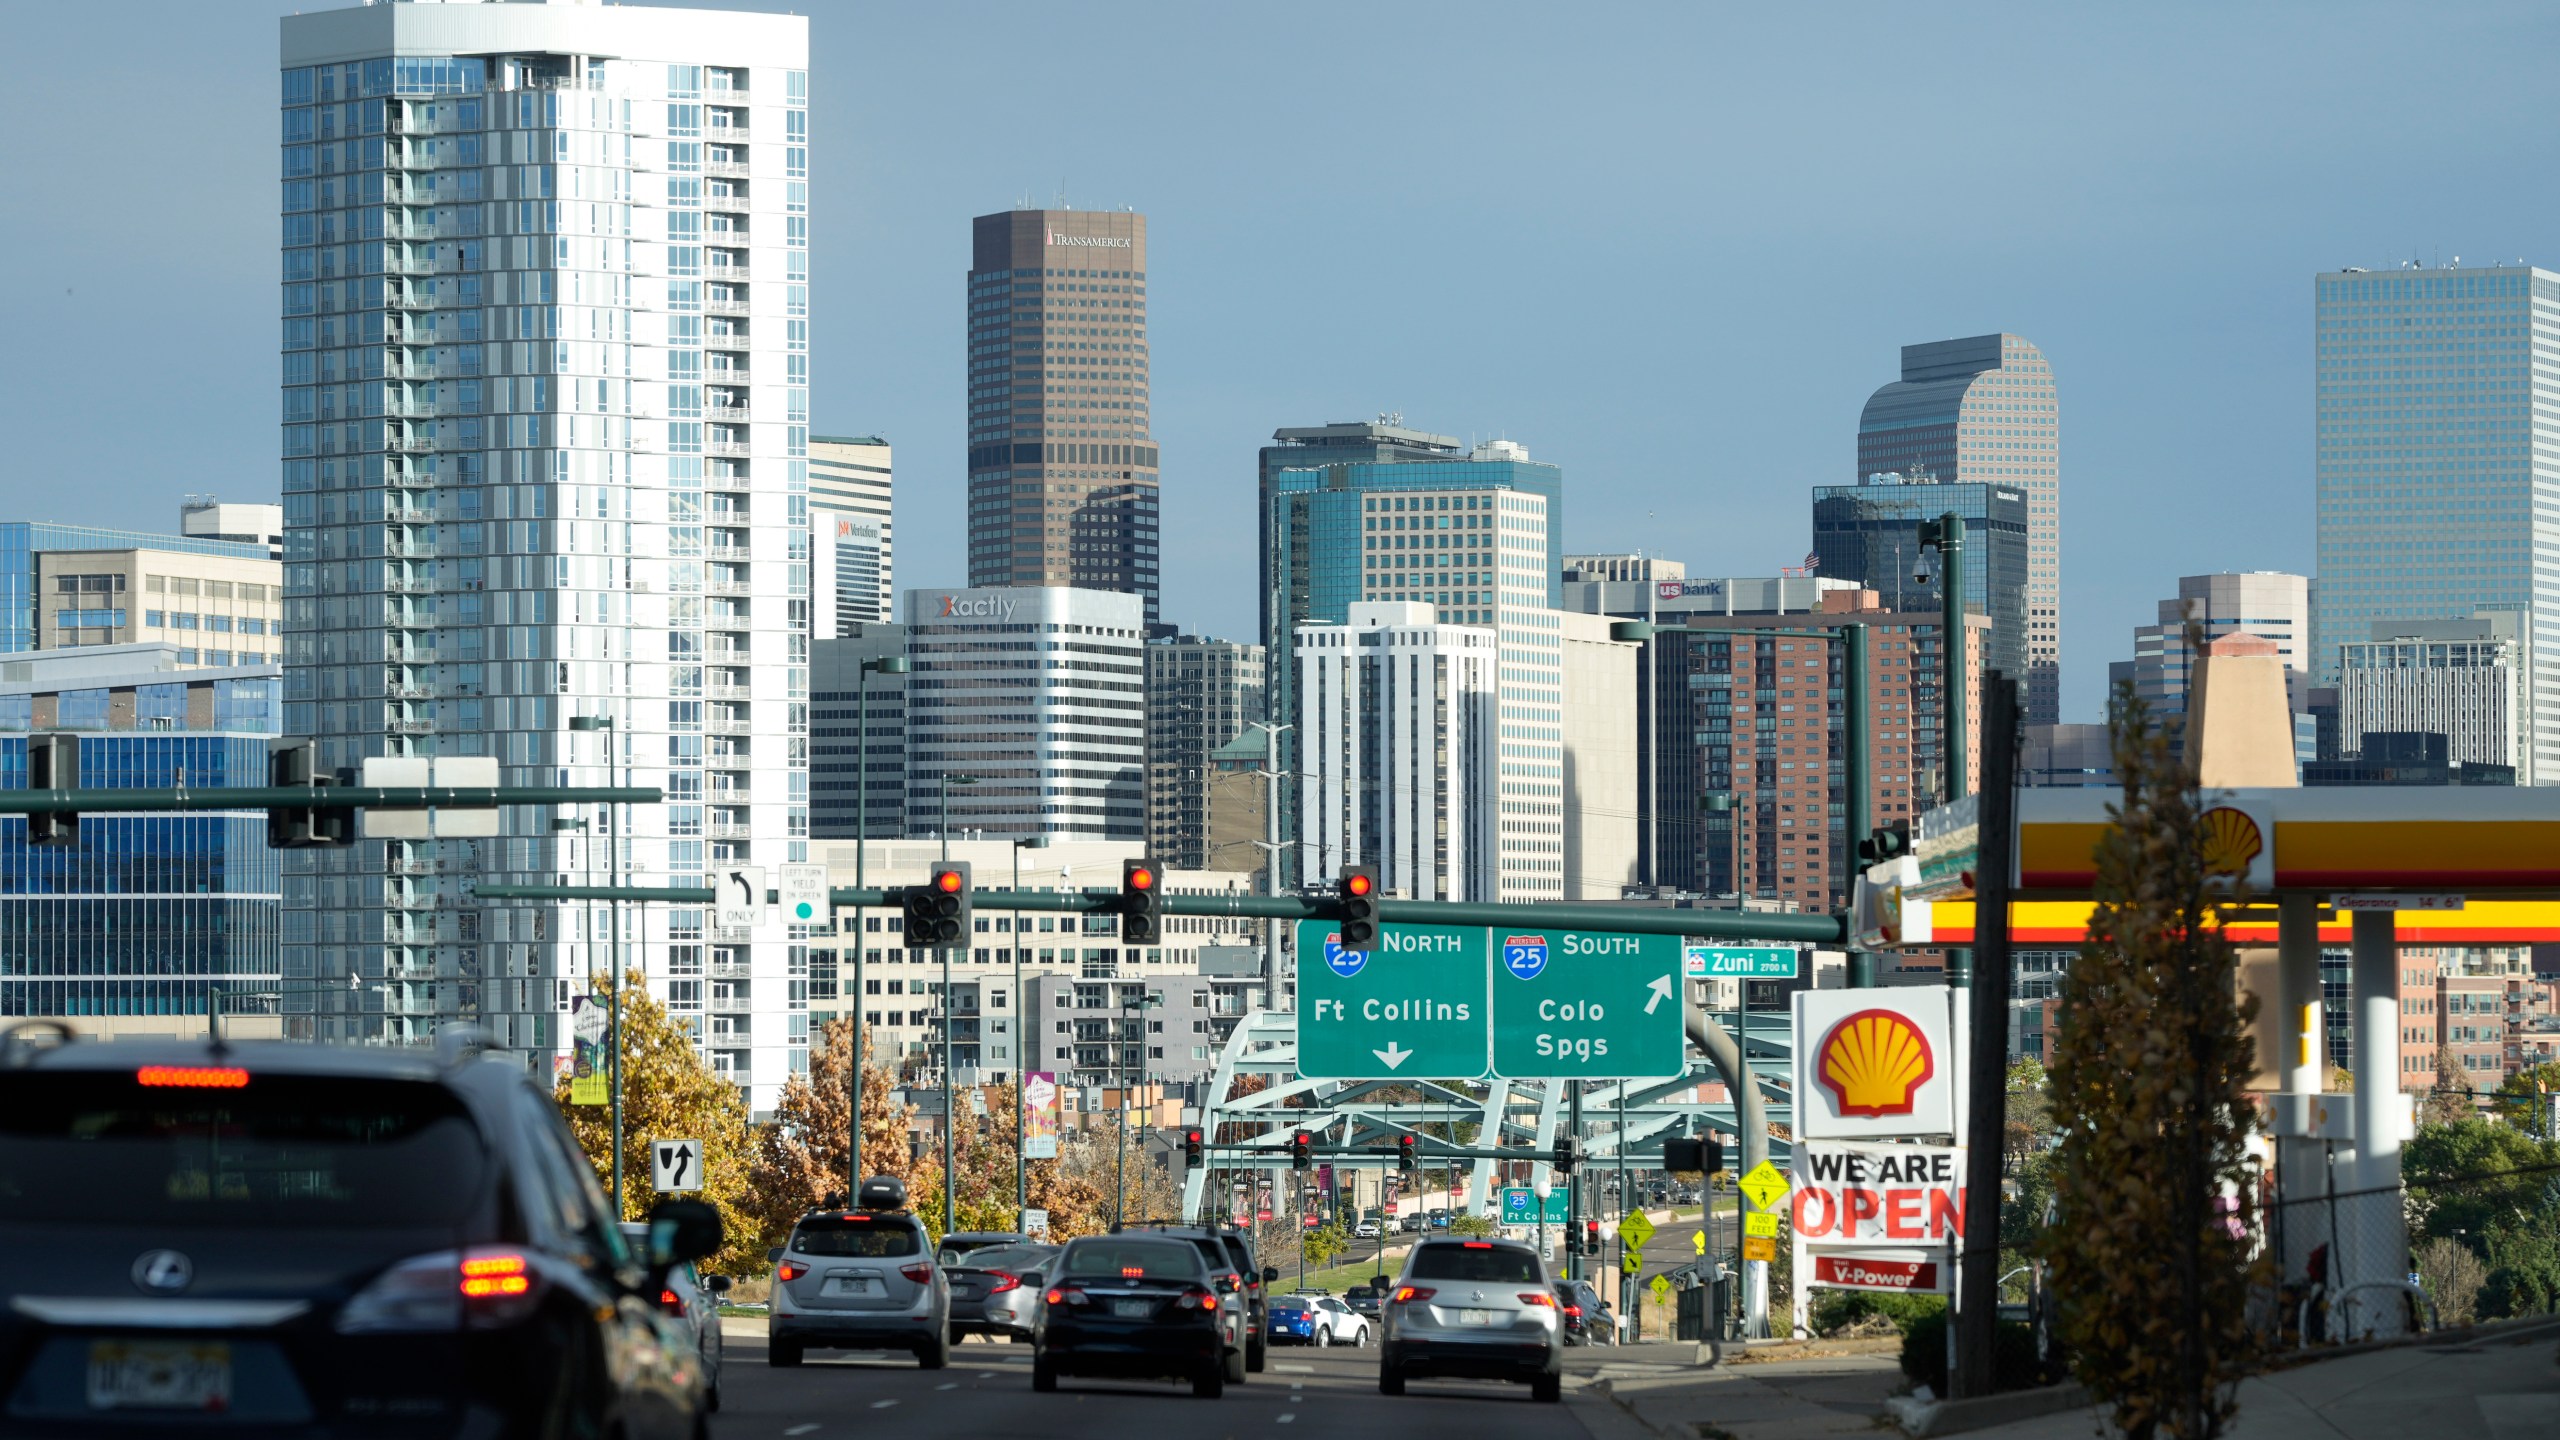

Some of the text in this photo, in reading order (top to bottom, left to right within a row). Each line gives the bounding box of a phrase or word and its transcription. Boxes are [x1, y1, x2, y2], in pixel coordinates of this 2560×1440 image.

[1054, 233, 1130, 248] TRANSAMERICA
[942, 594, 1017, 622] Xactly
[785, 869, 821, 877] LEFT TURN
[793, 880, 816, 889] YIELD
[726, 910, 755, 922] ONLY
[1383, 931, 1462, 953] NORTH
[1562, 934, 1640, 955] SOUTH
[1332, 945, 1362, 966] 25
[1511, 947, 1542, 969] 25
[1711, 952, 1754, 972] Zuni
[1760, 963, 1780, 972] 2700
[1315, 998, 1470, 1021] Ft Collins
[1538, 999, 1604, 1021] Colo
[1535, 1033, 1608, 1063] Spgs
[1810, 1154, 1952, 1183] WE ARE
[1512, 1196, 1526, 1206] 25
[1507, 1212, 1519, 1220] Ft
[1755, 1215, 1769, 1224] 100
[1793, 1186, 1967, 1239] OPEN
[1833, 1266, 1915, 1287] V-Power
